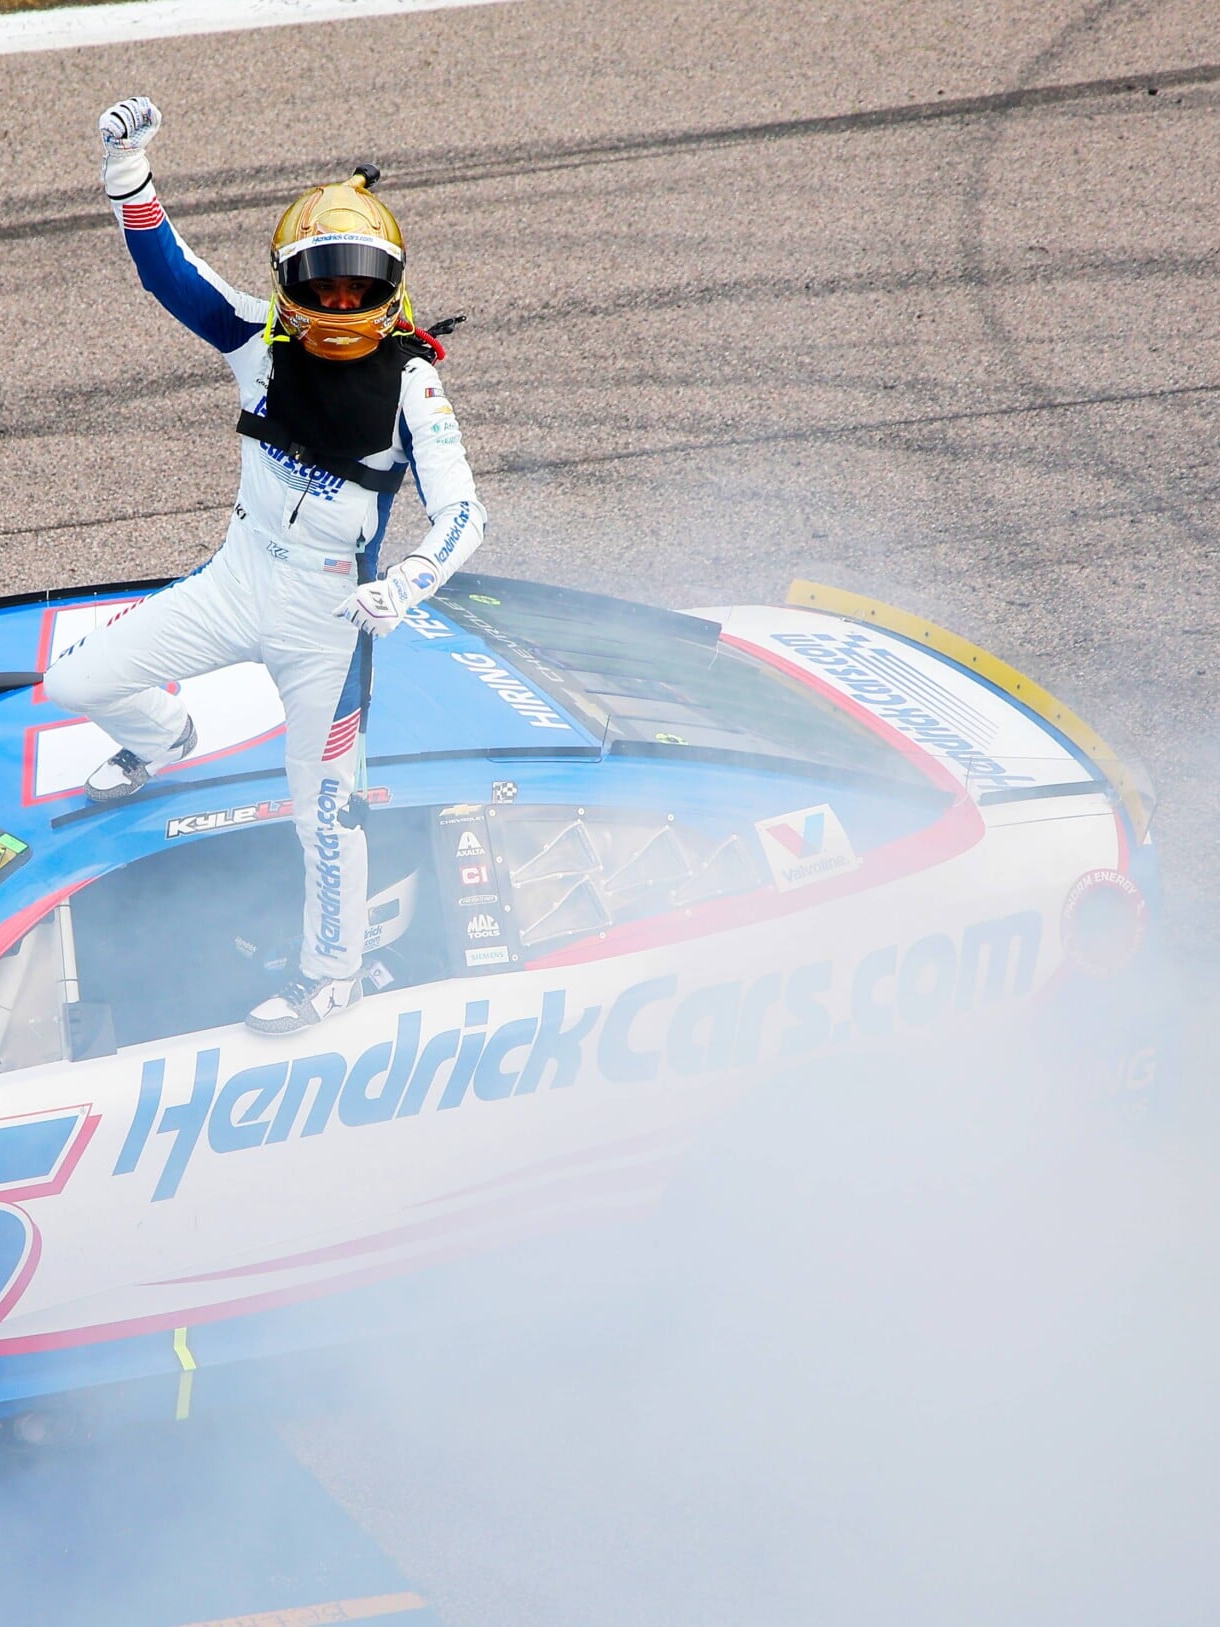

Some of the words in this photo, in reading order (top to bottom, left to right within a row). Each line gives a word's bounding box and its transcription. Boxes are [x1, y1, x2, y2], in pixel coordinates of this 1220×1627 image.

[450, 651, 572, 730] HIRING
[456, 848, 486, 858] AXALTA
[781, 855, 846, 885] Valvoline
[467, 914, 500, 933] MAC
[468, 929, 501, 940] TOOLS
[471, 951, 505, 961] SIEMENS
[113, 909, 1043, 1202] HendrickCars.com
